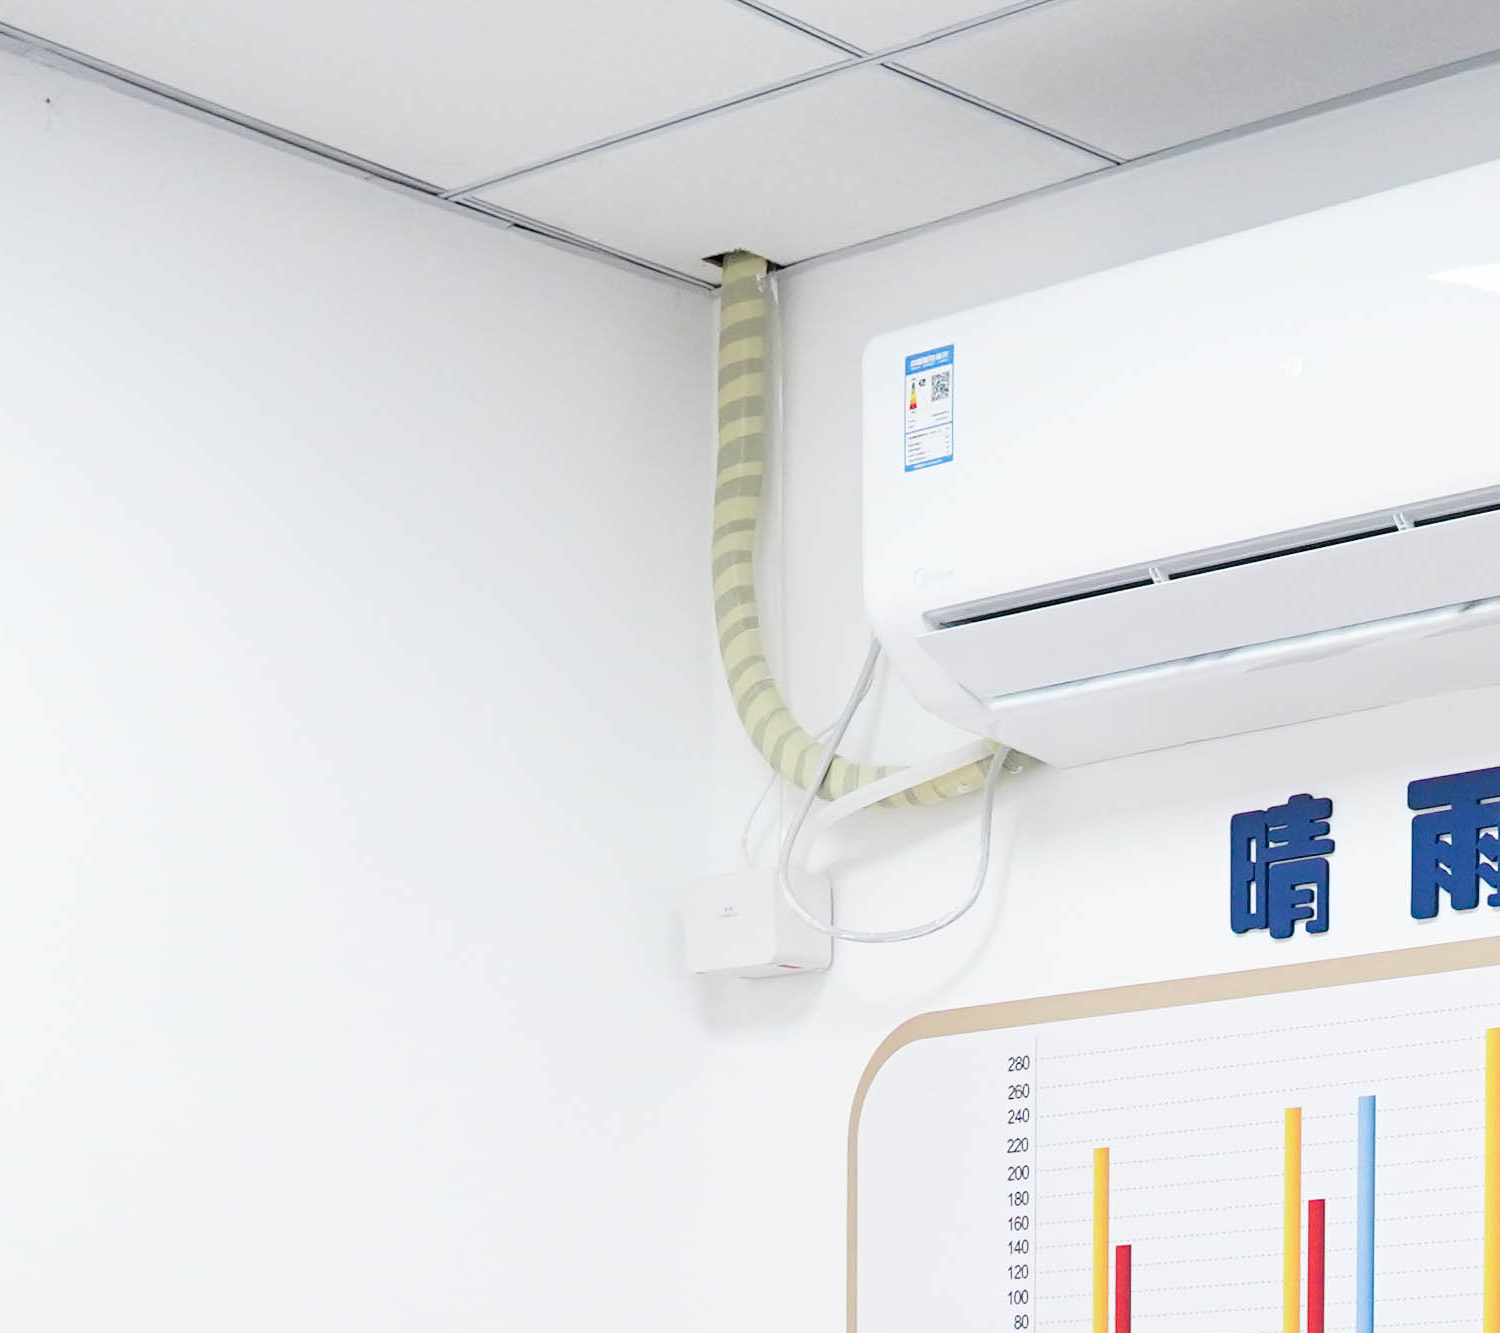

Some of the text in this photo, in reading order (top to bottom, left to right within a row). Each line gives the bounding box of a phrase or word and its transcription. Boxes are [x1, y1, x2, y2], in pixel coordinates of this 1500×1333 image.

[1007, 1055, 1031, 1072] 280
[1007, 1082, 1030, 1100] 260
[1007, 1107, 1030, 1124] 240
[1006, 1136, 1029, 1153] 220
[1007, 1164, 1030, 1181] 200
[1008, 1190, 1030, 1206] 180
[1008, 1215, 1030, 1231] 160
[1008, 1238, 1030, 1254] 140
[1007, 1263, 1029, 1279] 120
[1007, 1289, 1029, 1304] 100
[1013, 1313, 1030, 1329] 80
